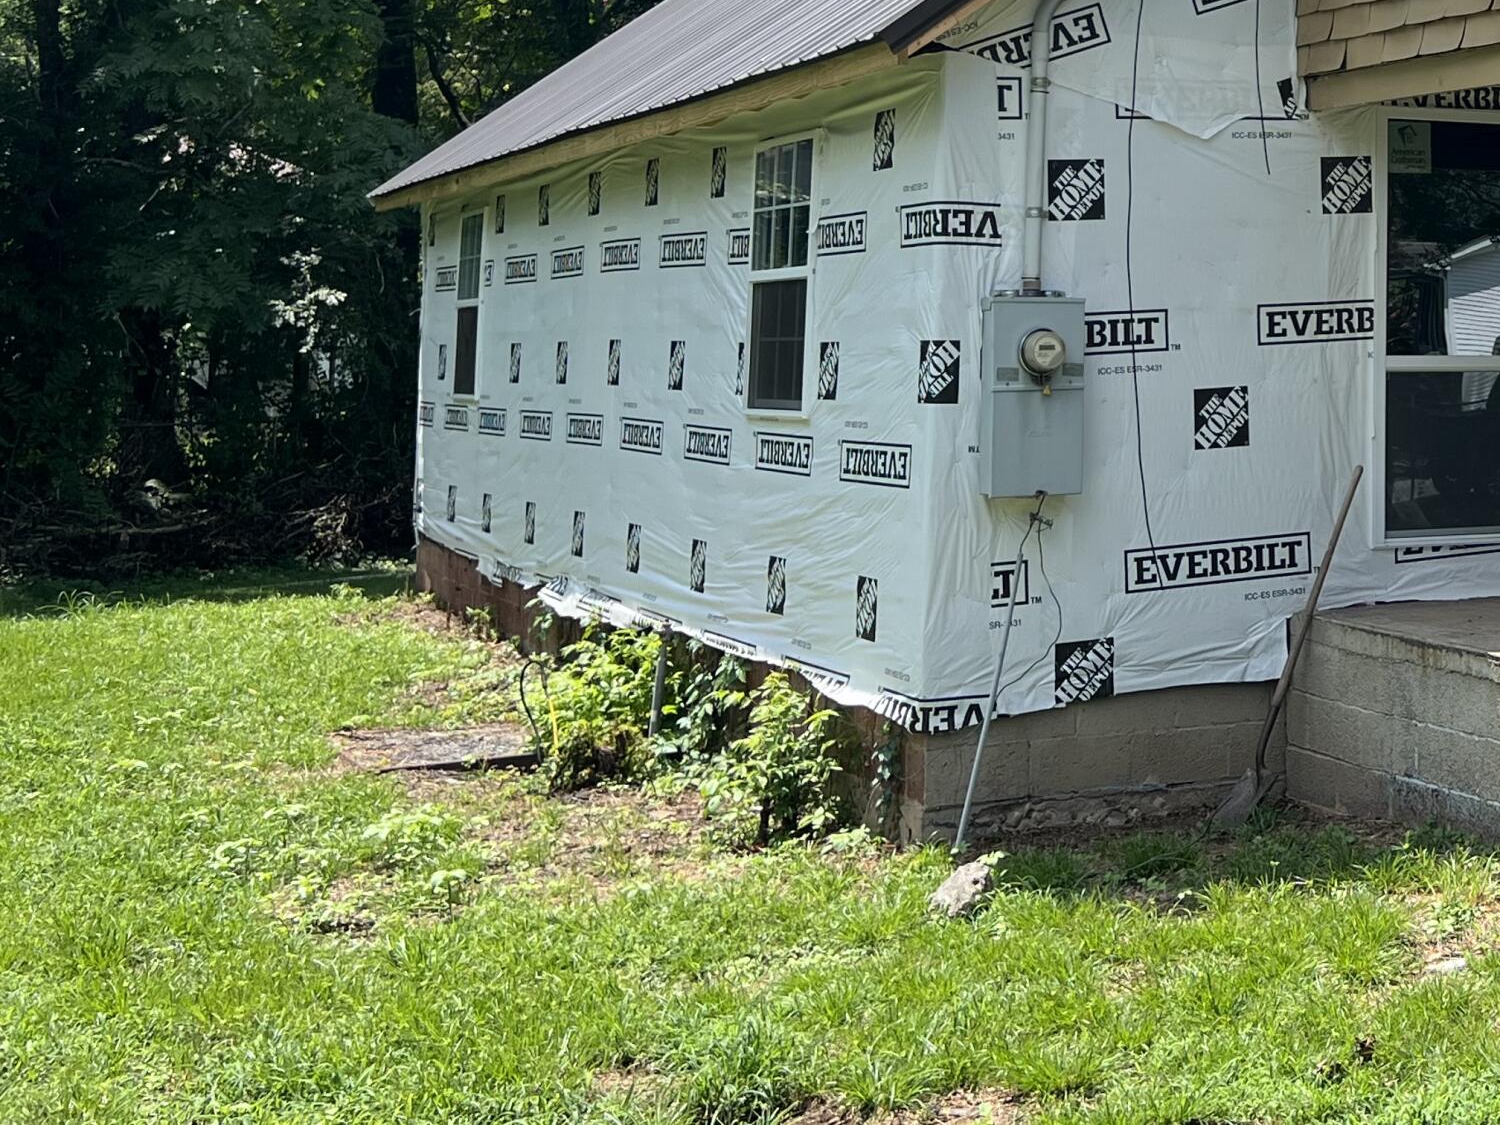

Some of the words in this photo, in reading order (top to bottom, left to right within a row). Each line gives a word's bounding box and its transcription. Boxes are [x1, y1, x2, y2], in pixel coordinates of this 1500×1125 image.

[1053, 164, 1077, 191] THE
[1322, 156, 1373, 214] HOME
[1325, 161, 1348, 186] THE
[1048, 159, 1105, 221] HOME
[1071, 183, 1105, 221] DEPOT
[1342, 178, 1373, 214] DEPOT
[603, 243, 638, 266] EVERBILT
[662, 237, 705, 262] EVERBILT
[1097, 366, 1125, 376] ICC-ES
[1194, 386, 1250, 450] HOME
[1199, 393, 1223, 420] THE
[622, 424, 661, 448] EVERBILT
[1216, 411, 1250, 448] DEPOT
[686, 431, 729, 459] EVERBILT
[758, 439, 810, 468] EVERBILT
[843, 448, 908, 480] EVERBILT
[1134, 541, 1302, 585] EVERBILT
[1245, 591, 1271, 601] ICC-ES
[1055, 638, 1114, 706] HOME
[1060, 646, 1085, 675] THE
[1078, 660, 1114, 703] DEPOT
